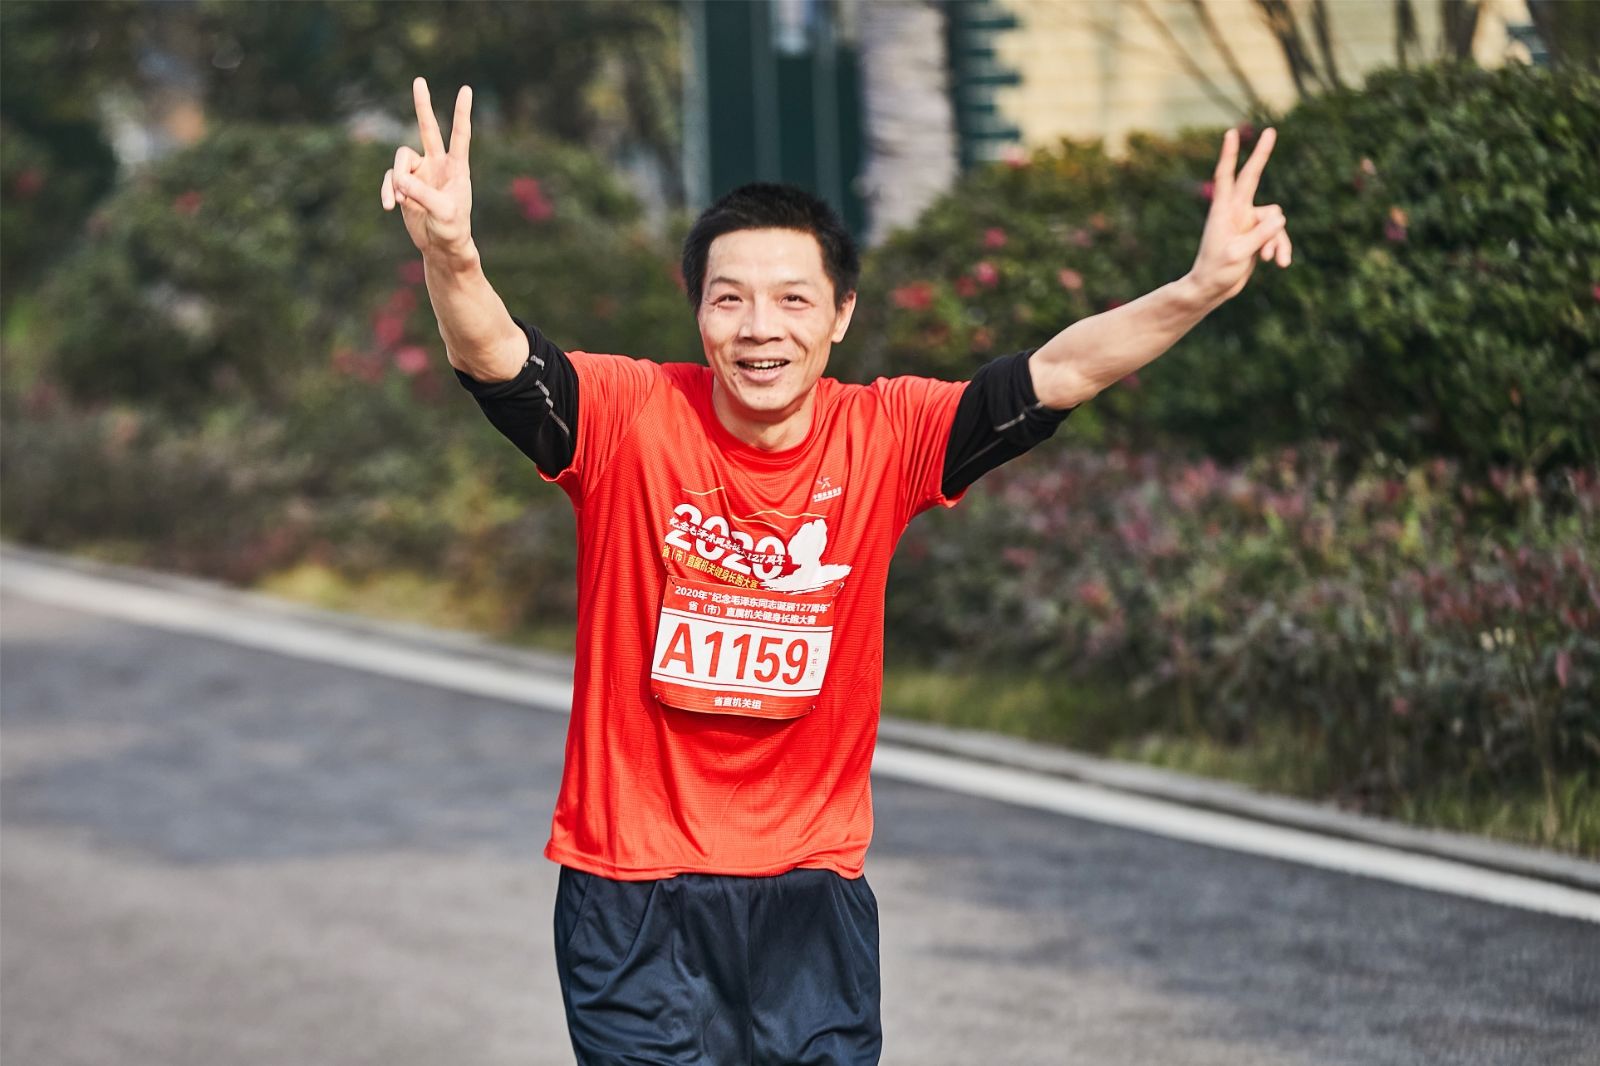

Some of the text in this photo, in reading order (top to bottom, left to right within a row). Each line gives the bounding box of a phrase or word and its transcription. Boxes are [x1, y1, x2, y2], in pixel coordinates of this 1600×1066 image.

[664, 503, 787, 581] 2020
[659, 622, 809, 685] A1159
[714, 696, 762, 710] 省直机关组
